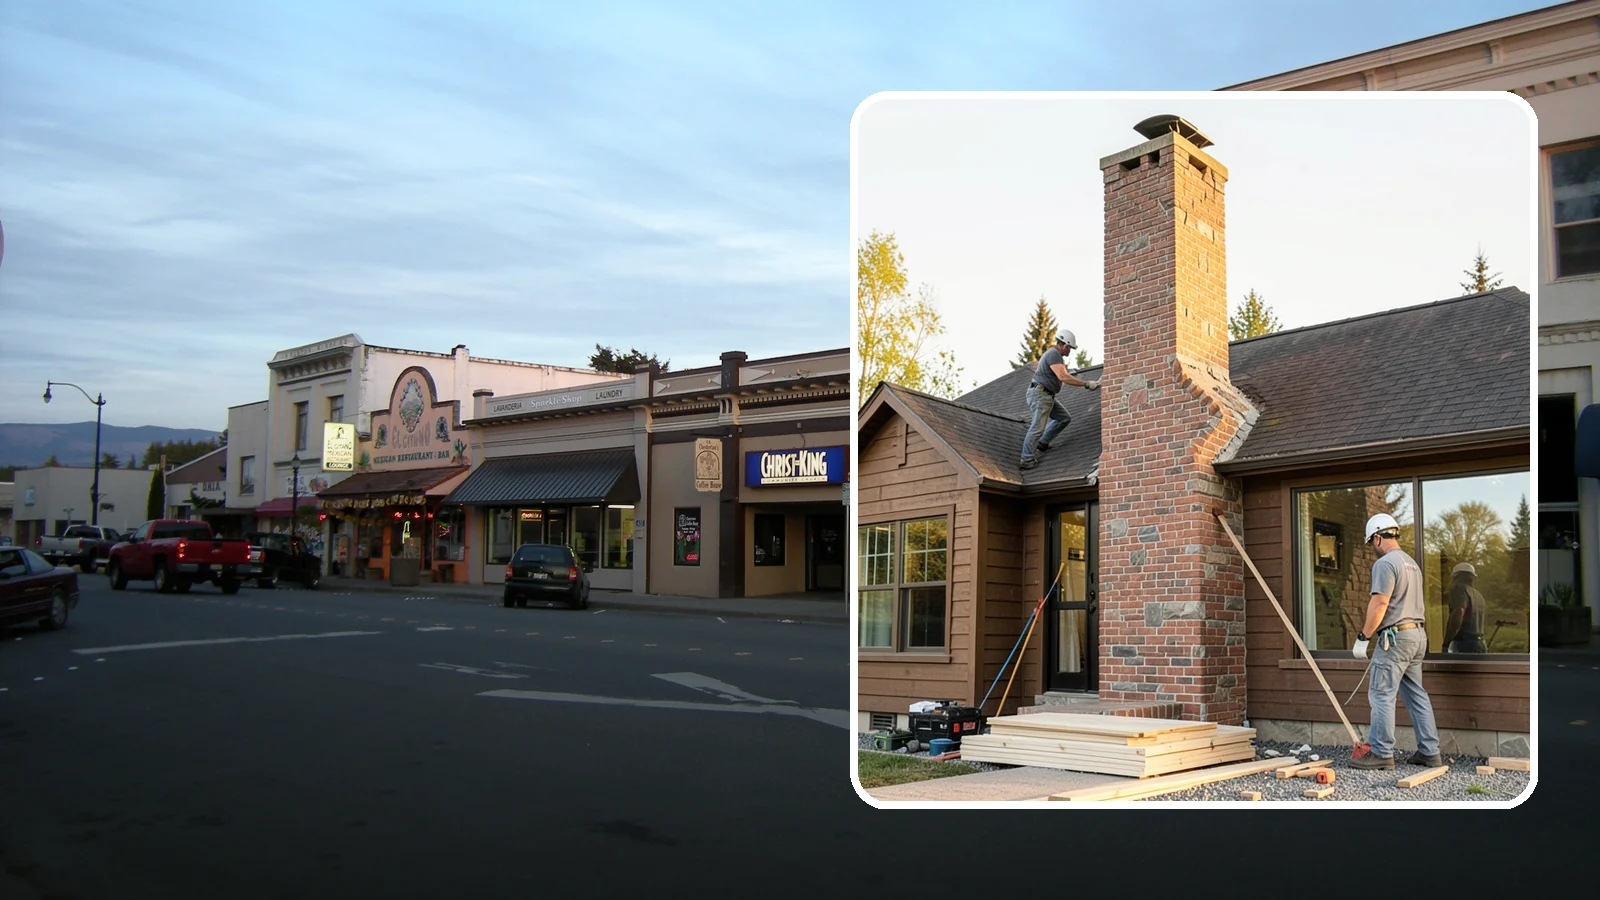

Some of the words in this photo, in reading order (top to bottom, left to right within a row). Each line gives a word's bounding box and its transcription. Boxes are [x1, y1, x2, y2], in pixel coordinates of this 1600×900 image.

[530, 396, 561, 409] Sparkle
[562, 394, 582, 404] Shop
[596, 389, 623, 400] LAUNDRY
[493, 402, 522, 412] LAVANDERIA
[392, 425, 402, 449] EL
[373, 454, 396, 464] MEXICAN
[397, 451, 433, 462] RESTAURANT
[438, 450, 450, 459] BAR
[761, 452, 797, 478] CHRIST
[799, 450, 827, 476] KING
